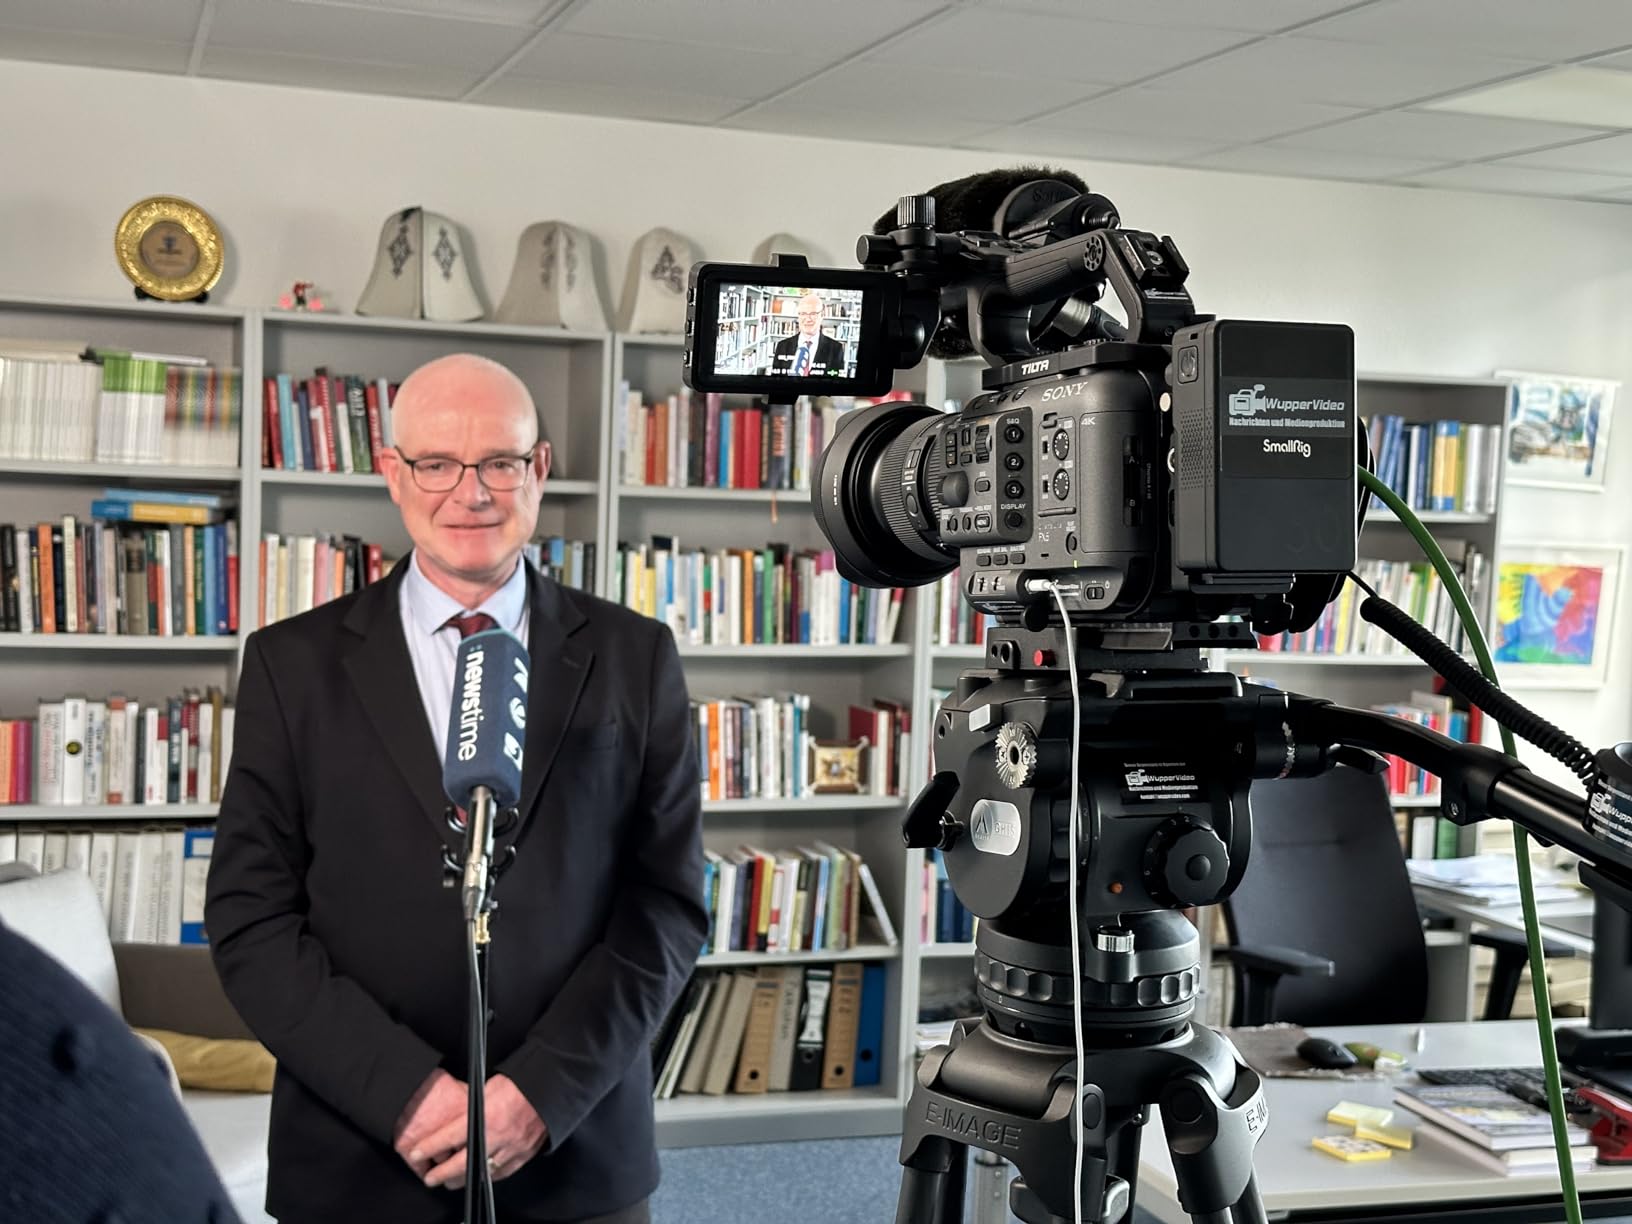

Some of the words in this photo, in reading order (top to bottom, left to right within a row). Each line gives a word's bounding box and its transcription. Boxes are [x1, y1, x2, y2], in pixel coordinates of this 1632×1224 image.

[1021, 359, 1049, 375] TILTA
[1041, 381, 1088, 401] SONY
[1266, 398, 1345, 412] WupperVideo
[1081, 416, 1096, 426] 4K
[1263, 439, 1311, 458] SmallRig
[1607, 803, 1632, 824] Wupp
[925, 1101, 1022, 1150] E-IMAGE
